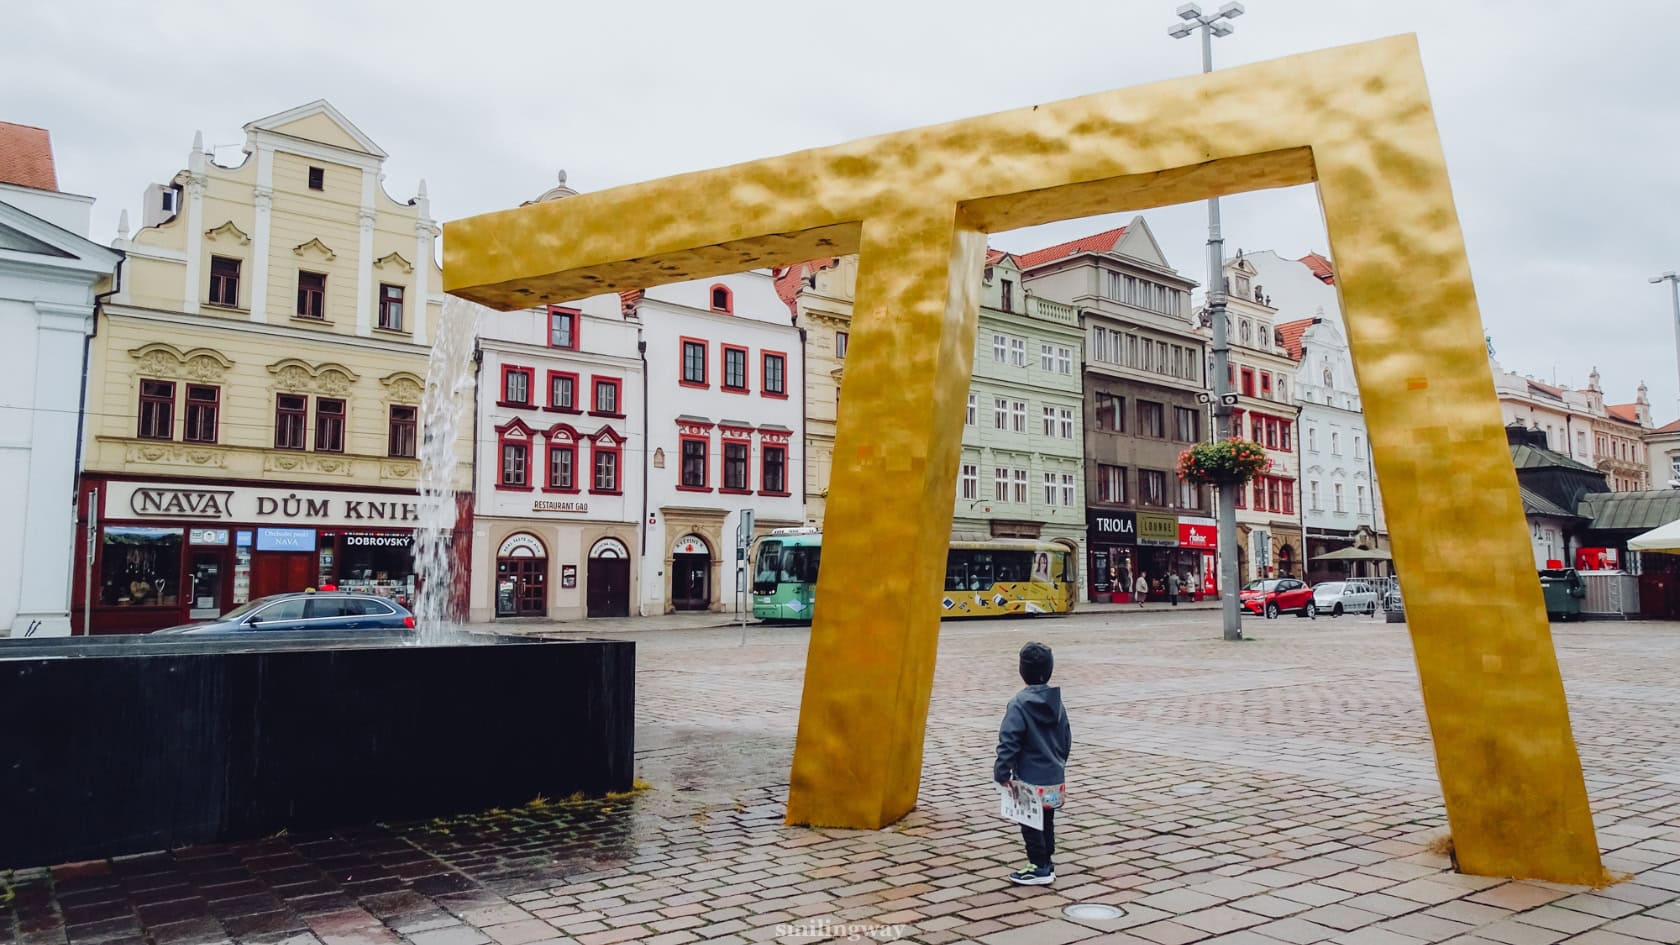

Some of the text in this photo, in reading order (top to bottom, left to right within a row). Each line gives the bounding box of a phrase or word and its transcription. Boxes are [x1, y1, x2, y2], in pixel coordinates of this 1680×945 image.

[140, 491, 222, 513] NAVA
[256, 493, 438, 521] DŮM KNIH
[534, 500, 574, 510] RESTAURANT
[1097, 518, 1134, 533] TRIOLA
[347, 536, 410, 547] DOBROVSKÝ
